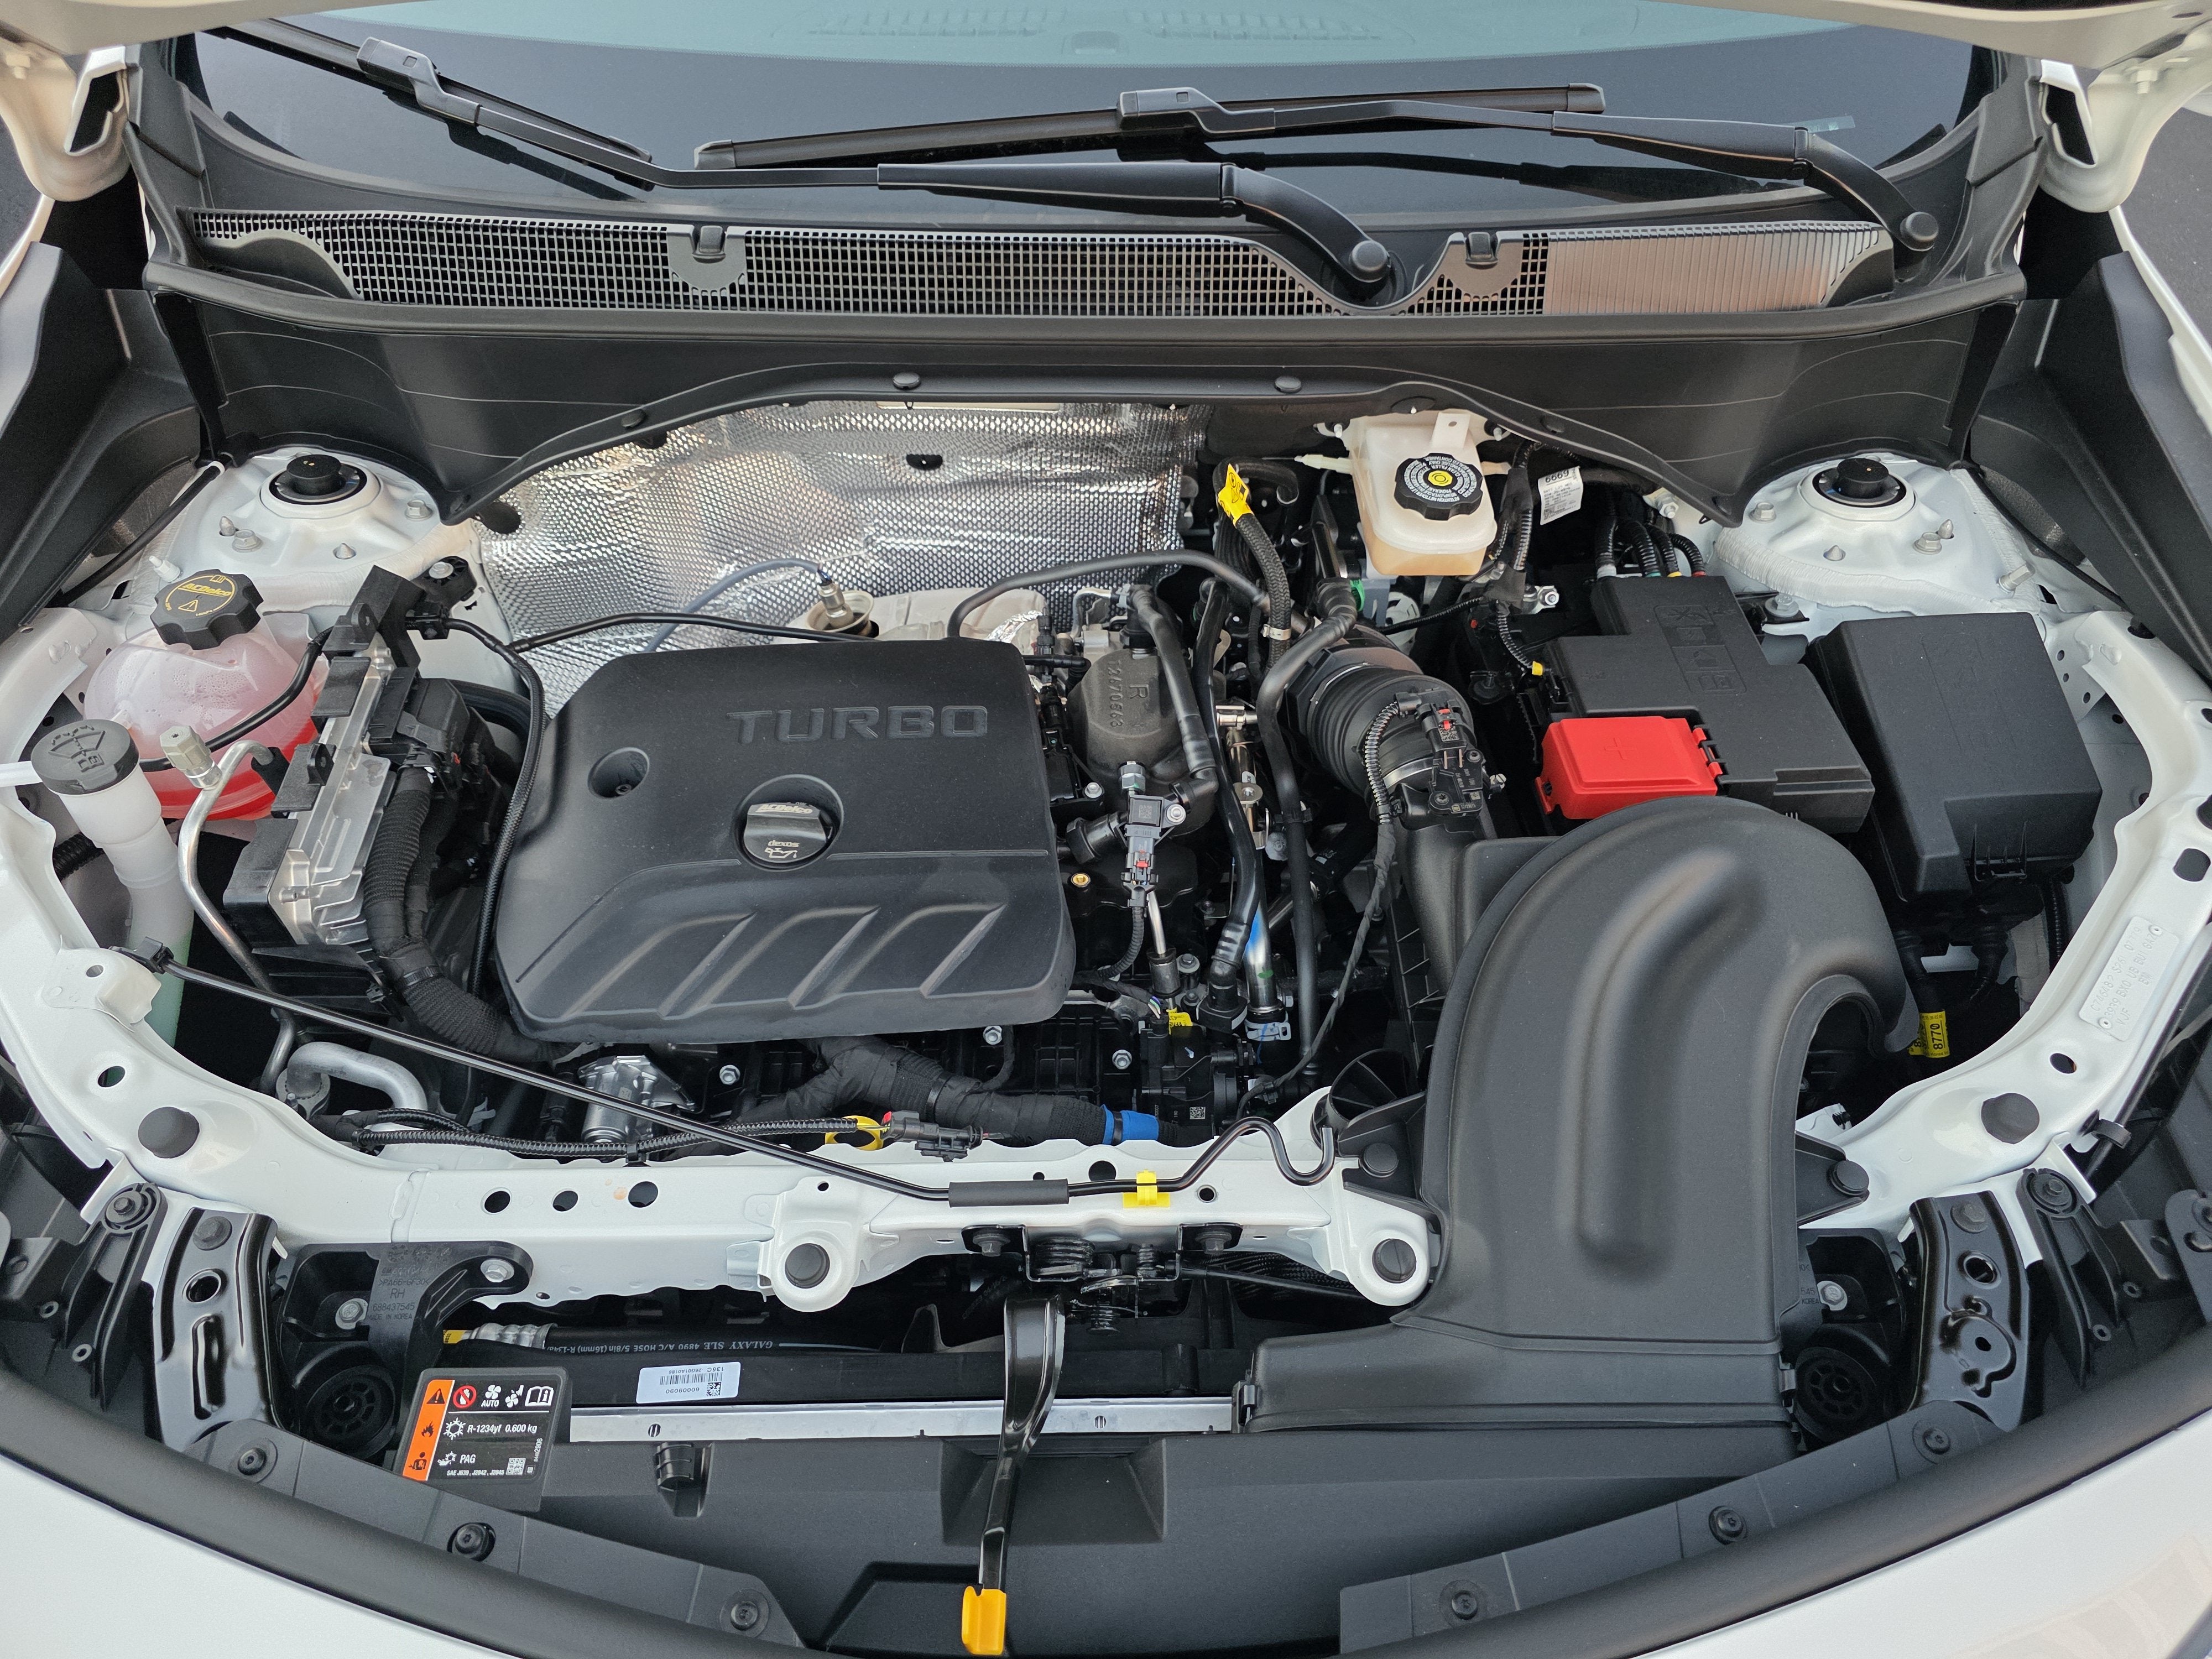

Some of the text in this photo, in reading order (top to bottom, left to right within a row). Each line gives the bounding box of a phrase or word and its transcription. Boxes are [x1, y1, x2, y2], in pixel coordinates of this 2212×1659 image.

[1545, 469, 1569, 483] 6669
[181, 583, 233, 597] ACDelco
[1128, 684, 1149, 700] R
[727, 705, 988, 744] TURBO
[757, 804, 813, 814] ACDelco
[768, 839, 800, 848] dexos
[1929, 1023, 1943, 1050] 8770
[390, 1288, 405, 1298] RH
[373, 1302, 415, 1311] 688437545
[577, 1344, 607, 1353] (16mm)
[703, 1342, 724, 1350] SLE
[729, 1340, 773, 1349] GALAXY
[467, 1424, 537, 1434] R-1234yf 0.600 kg
[460, 1454, 476, 1464] PAG
